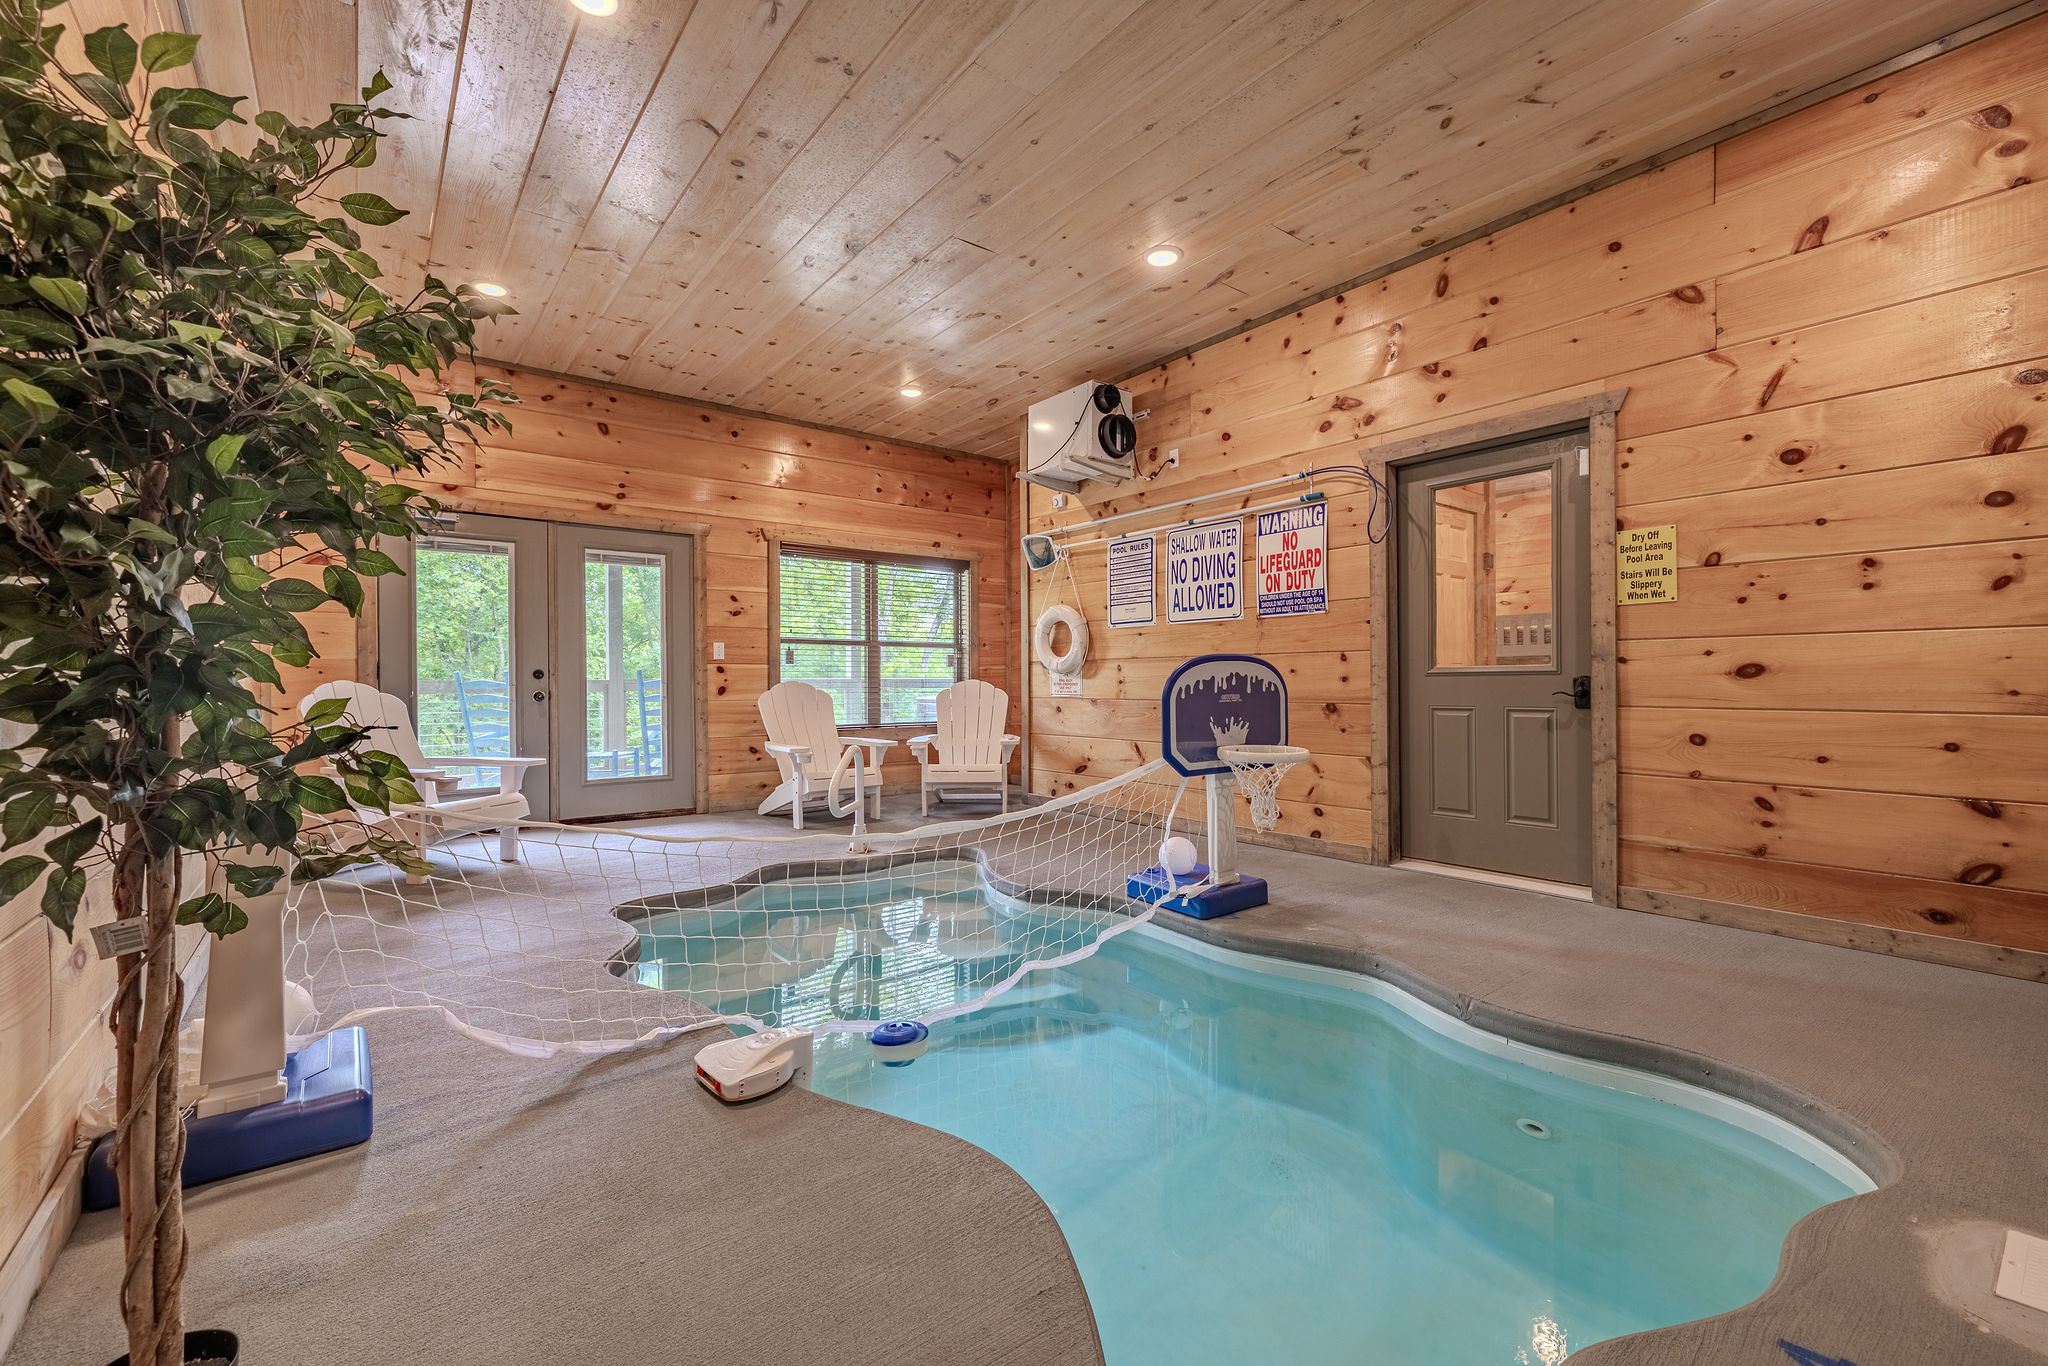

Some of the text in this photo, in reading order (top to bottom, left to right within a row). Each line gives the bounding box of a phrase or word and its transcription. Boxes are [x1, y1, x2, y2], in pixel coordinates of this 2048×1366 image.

[1260, 505, 1323, 535] WARNING
[1171, 528, 1237, 556] SHALLOW WATER
[1282, 531, 1298, 551] NO
[1632, 531, 1660, 543] Dry Off
[1112, 542, 1149, 555] POOL RULES
[1620, 541, 1672, 554] Before Leaving
[1260, 548, 1322, 574] LIFEGUARD
[1626, 553, 1664, 563] Pool Area
[1171, 551, 1236, 585] NO DIVING
[1620, 567, 1673, 580] Stairs Will Be
[1266, 569, 1316, 593] ON DUTY
[1630, 580, 1662, 590] Slippery
[1173, 582, 1235, 613] ALLOWED
[1627, 589, 1666, 600] When Wet
[1299, 603, 1325, 611] ATTENDANCE
